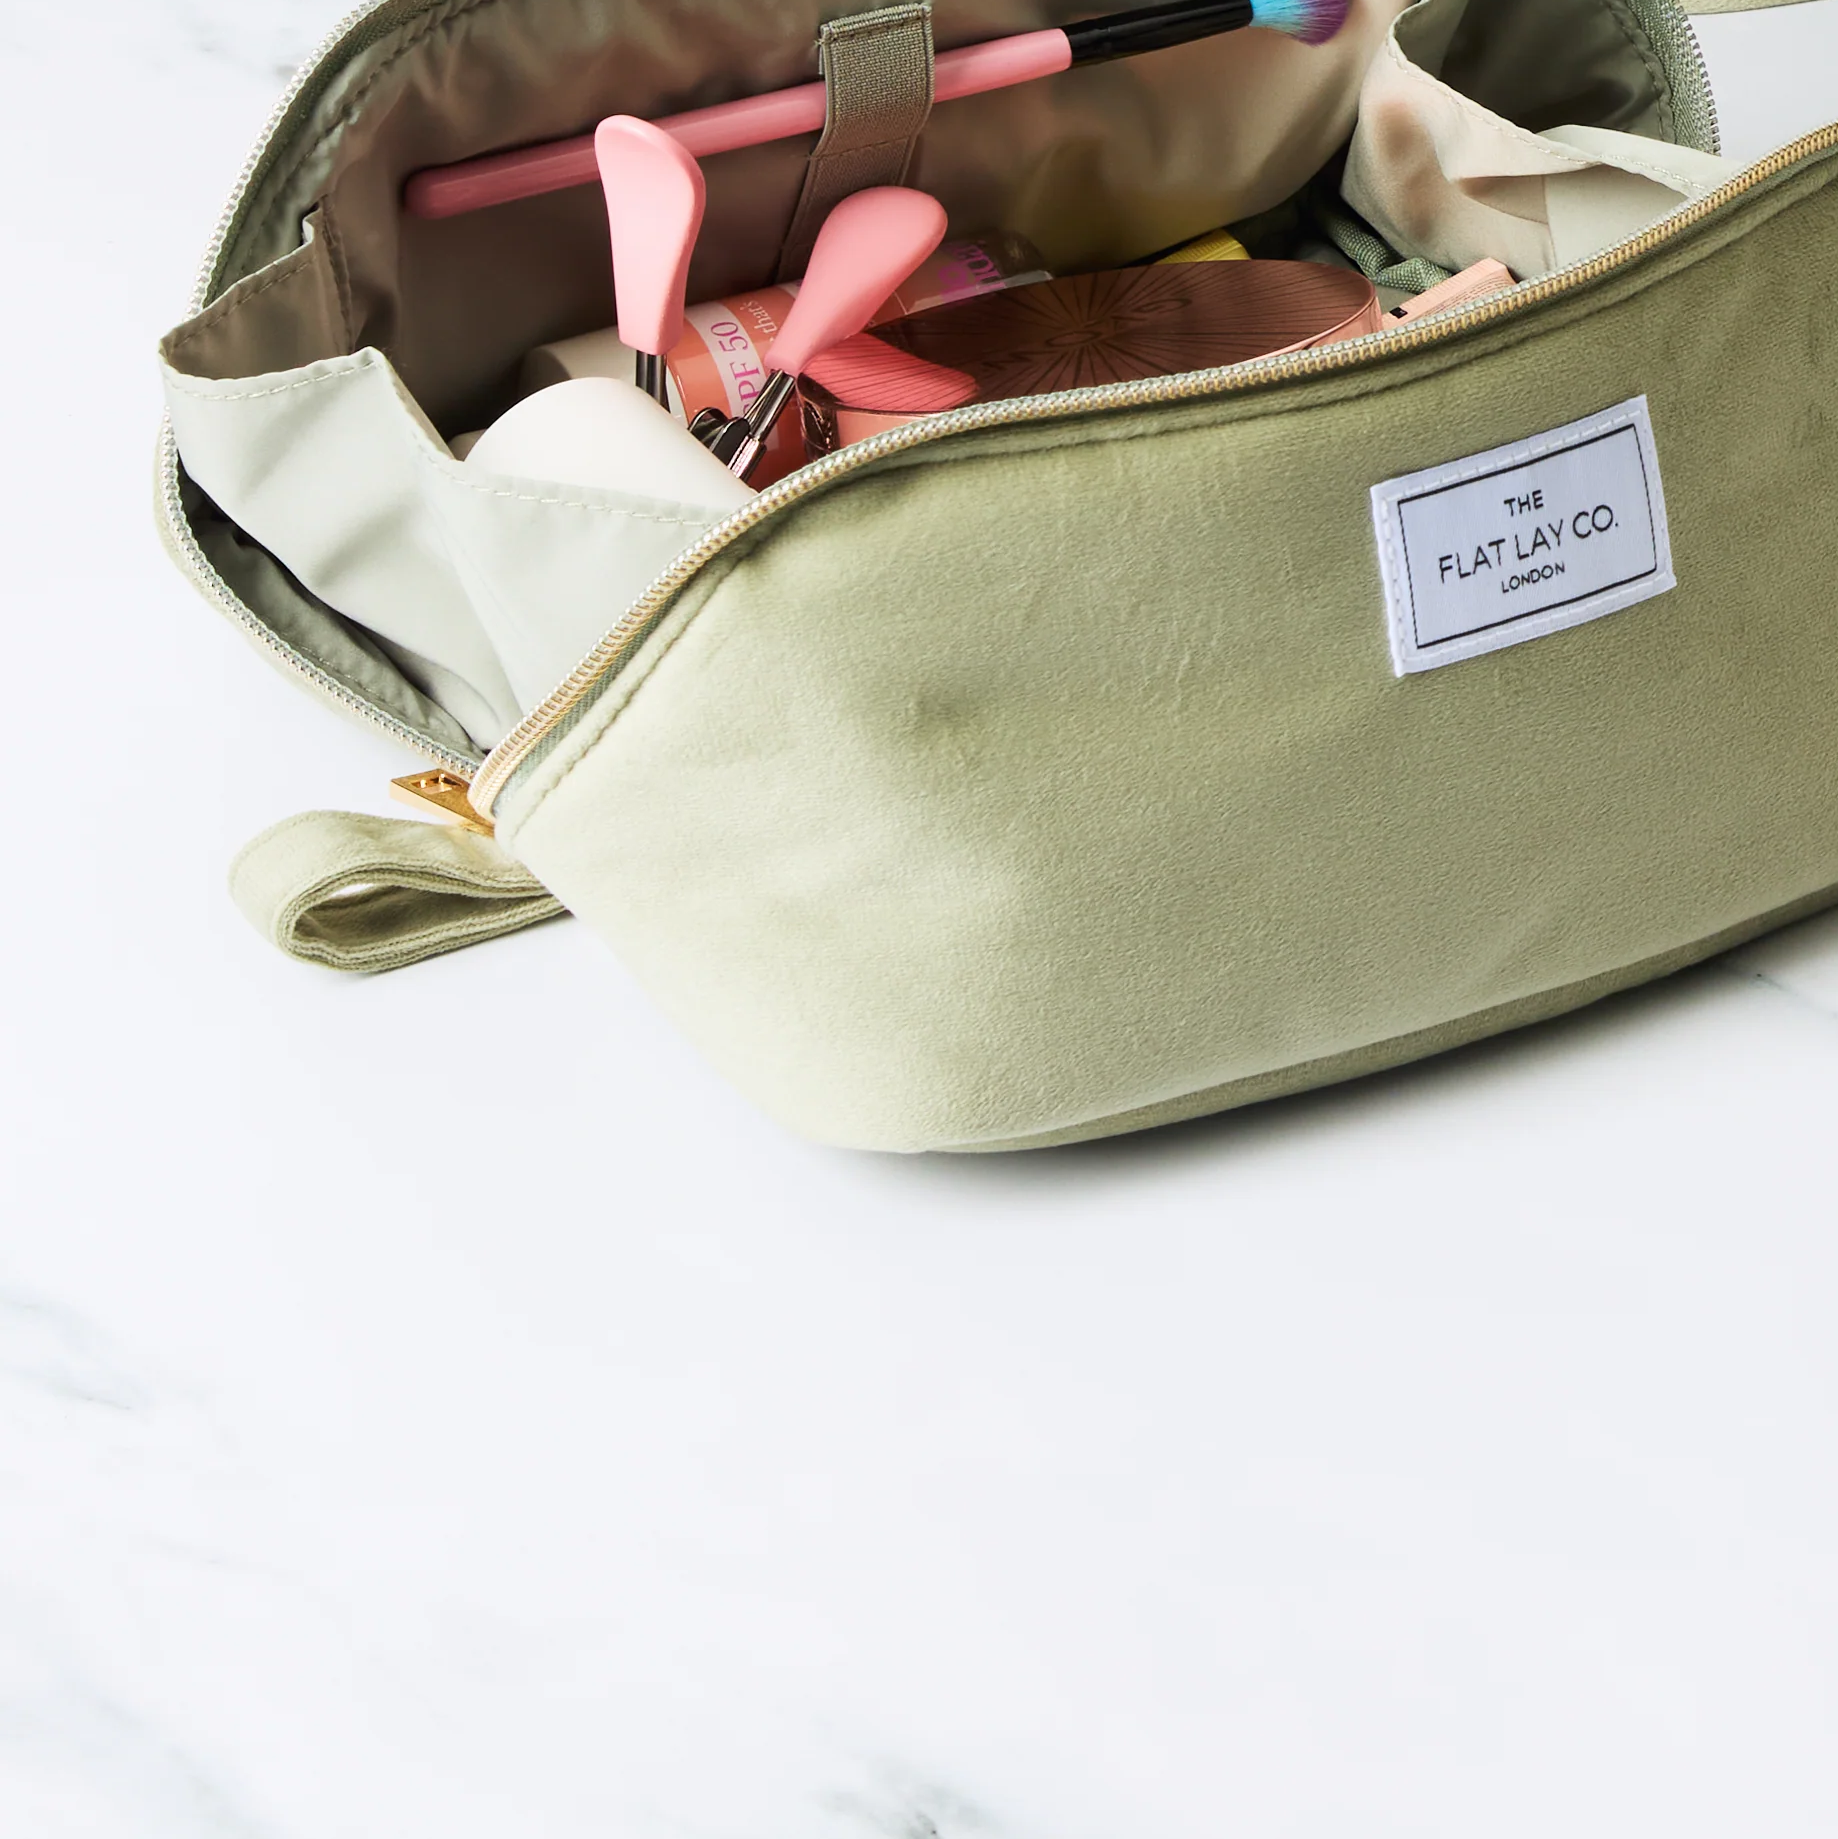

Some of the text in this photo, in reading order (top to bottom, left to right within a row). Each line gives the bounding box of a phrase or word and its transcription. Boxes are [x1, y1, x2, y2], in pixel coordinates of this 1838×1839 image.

[710, 321, 749, 353] 50
[1503, 489, 1545, 517] THE
[1438, 503, 1619, 584] FLAT LAY CO.
[1500, 561, 1566, 594] LONDON
